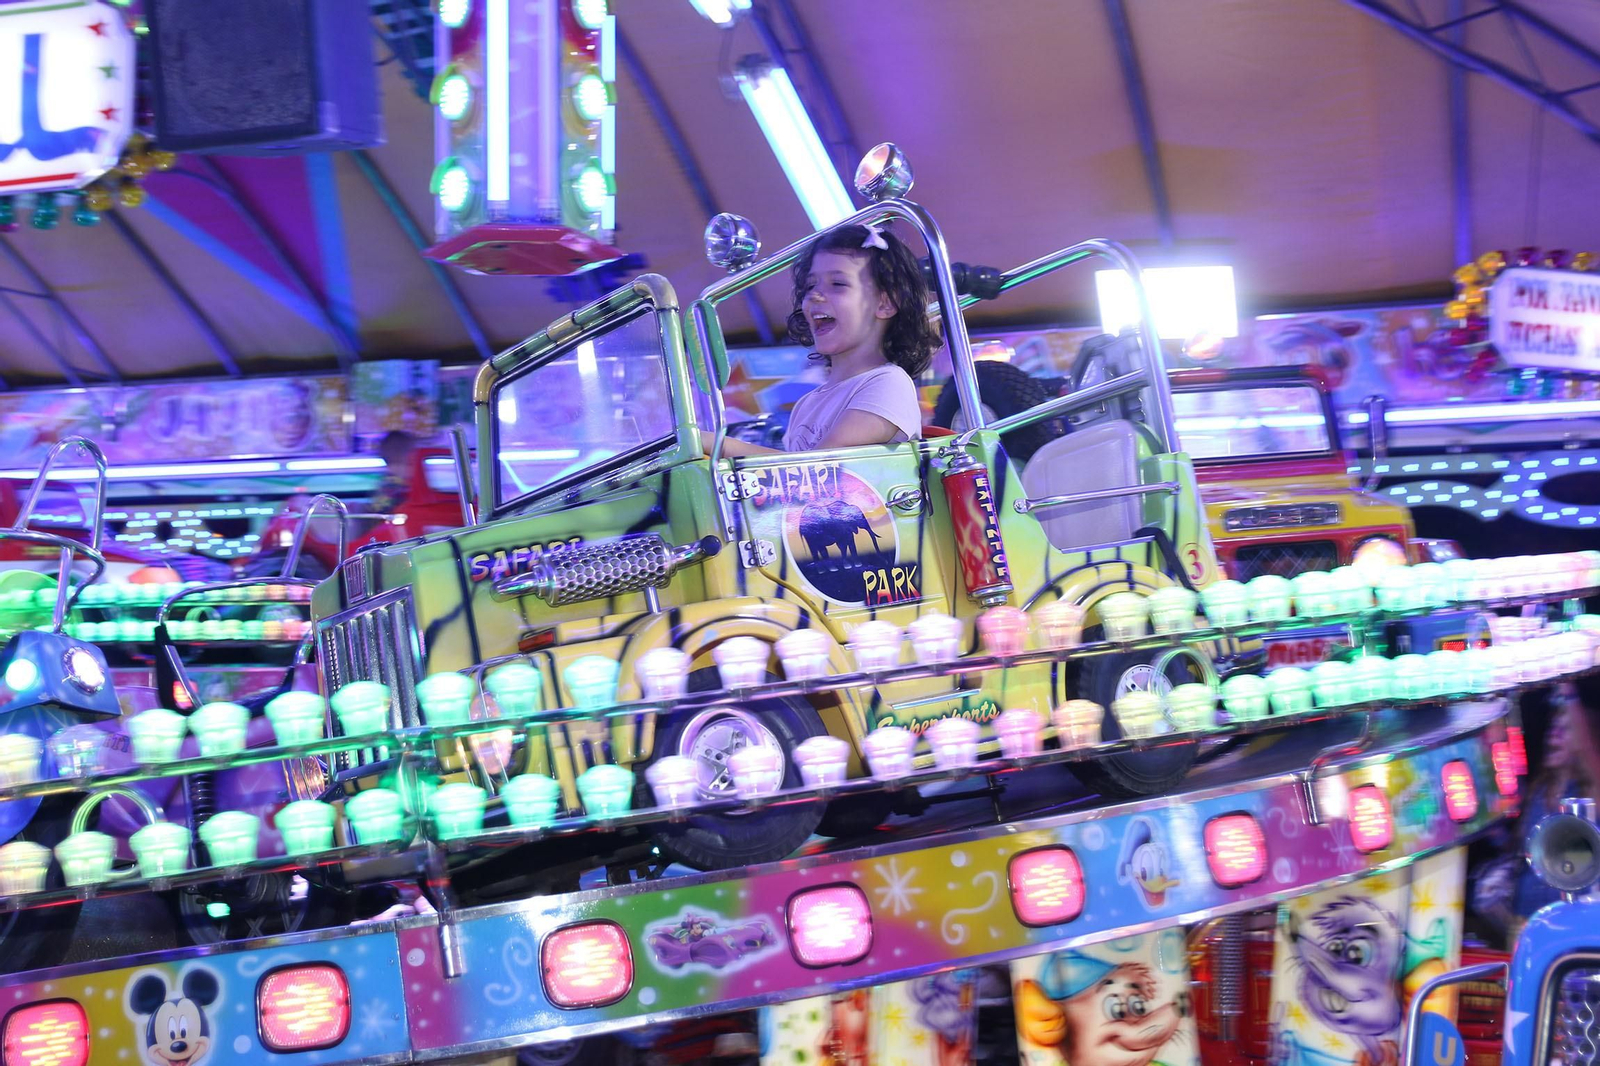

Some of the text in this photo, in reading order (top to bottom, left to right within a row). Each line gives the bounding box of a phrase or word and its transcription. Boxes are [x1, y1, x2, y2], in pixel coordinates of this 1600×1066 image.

[752, 461, 842, 508] SAFARI
[1187, 549, 1204, 580] 3
[862, 565, 921, 607] PARK
